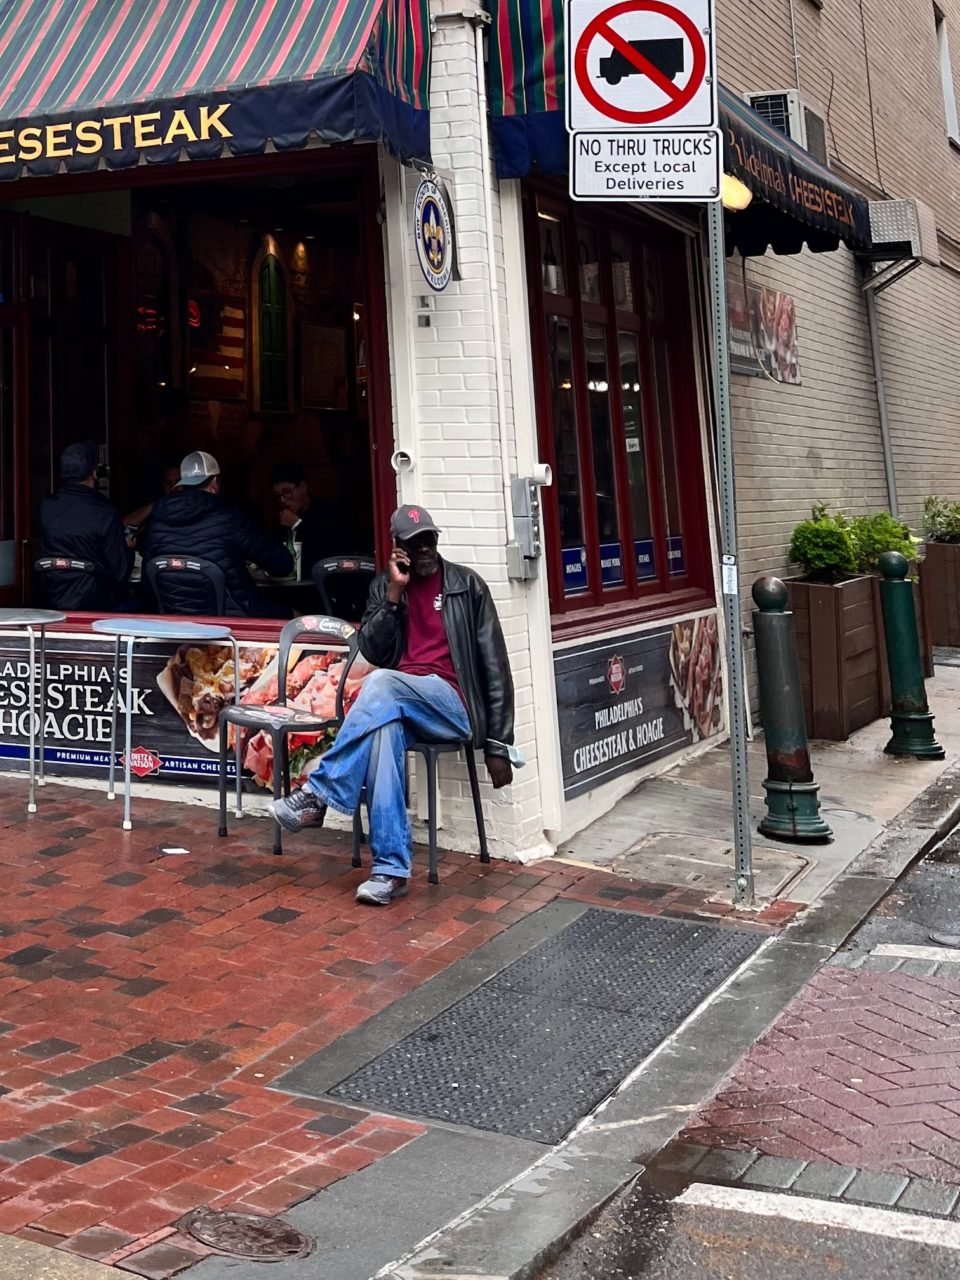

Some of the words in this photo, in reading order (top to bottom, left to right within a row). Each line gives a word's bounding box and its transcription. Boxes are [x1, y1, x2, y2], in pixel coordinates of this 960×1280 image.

[579, 139, 603, 157] NO
[606, 139, 648, 157] THRU
[652, 138, 712, 157] TRUCKS
[594, 160, 647, 178] Except
[653, 158, 696, 174] Local
[606, 176, 685, 192] Deliveries
[594, 697, 644, 731] PHILADELPHIA'S
[573, 730, 630, 774] CHEESESTEAK
[628, 728, 637, 751] &
[636, 717, 665, 749] HOAGIE
[56, 752, 91, 762] PREMIUM
[164, 761, 198, 770] ARTISAN
